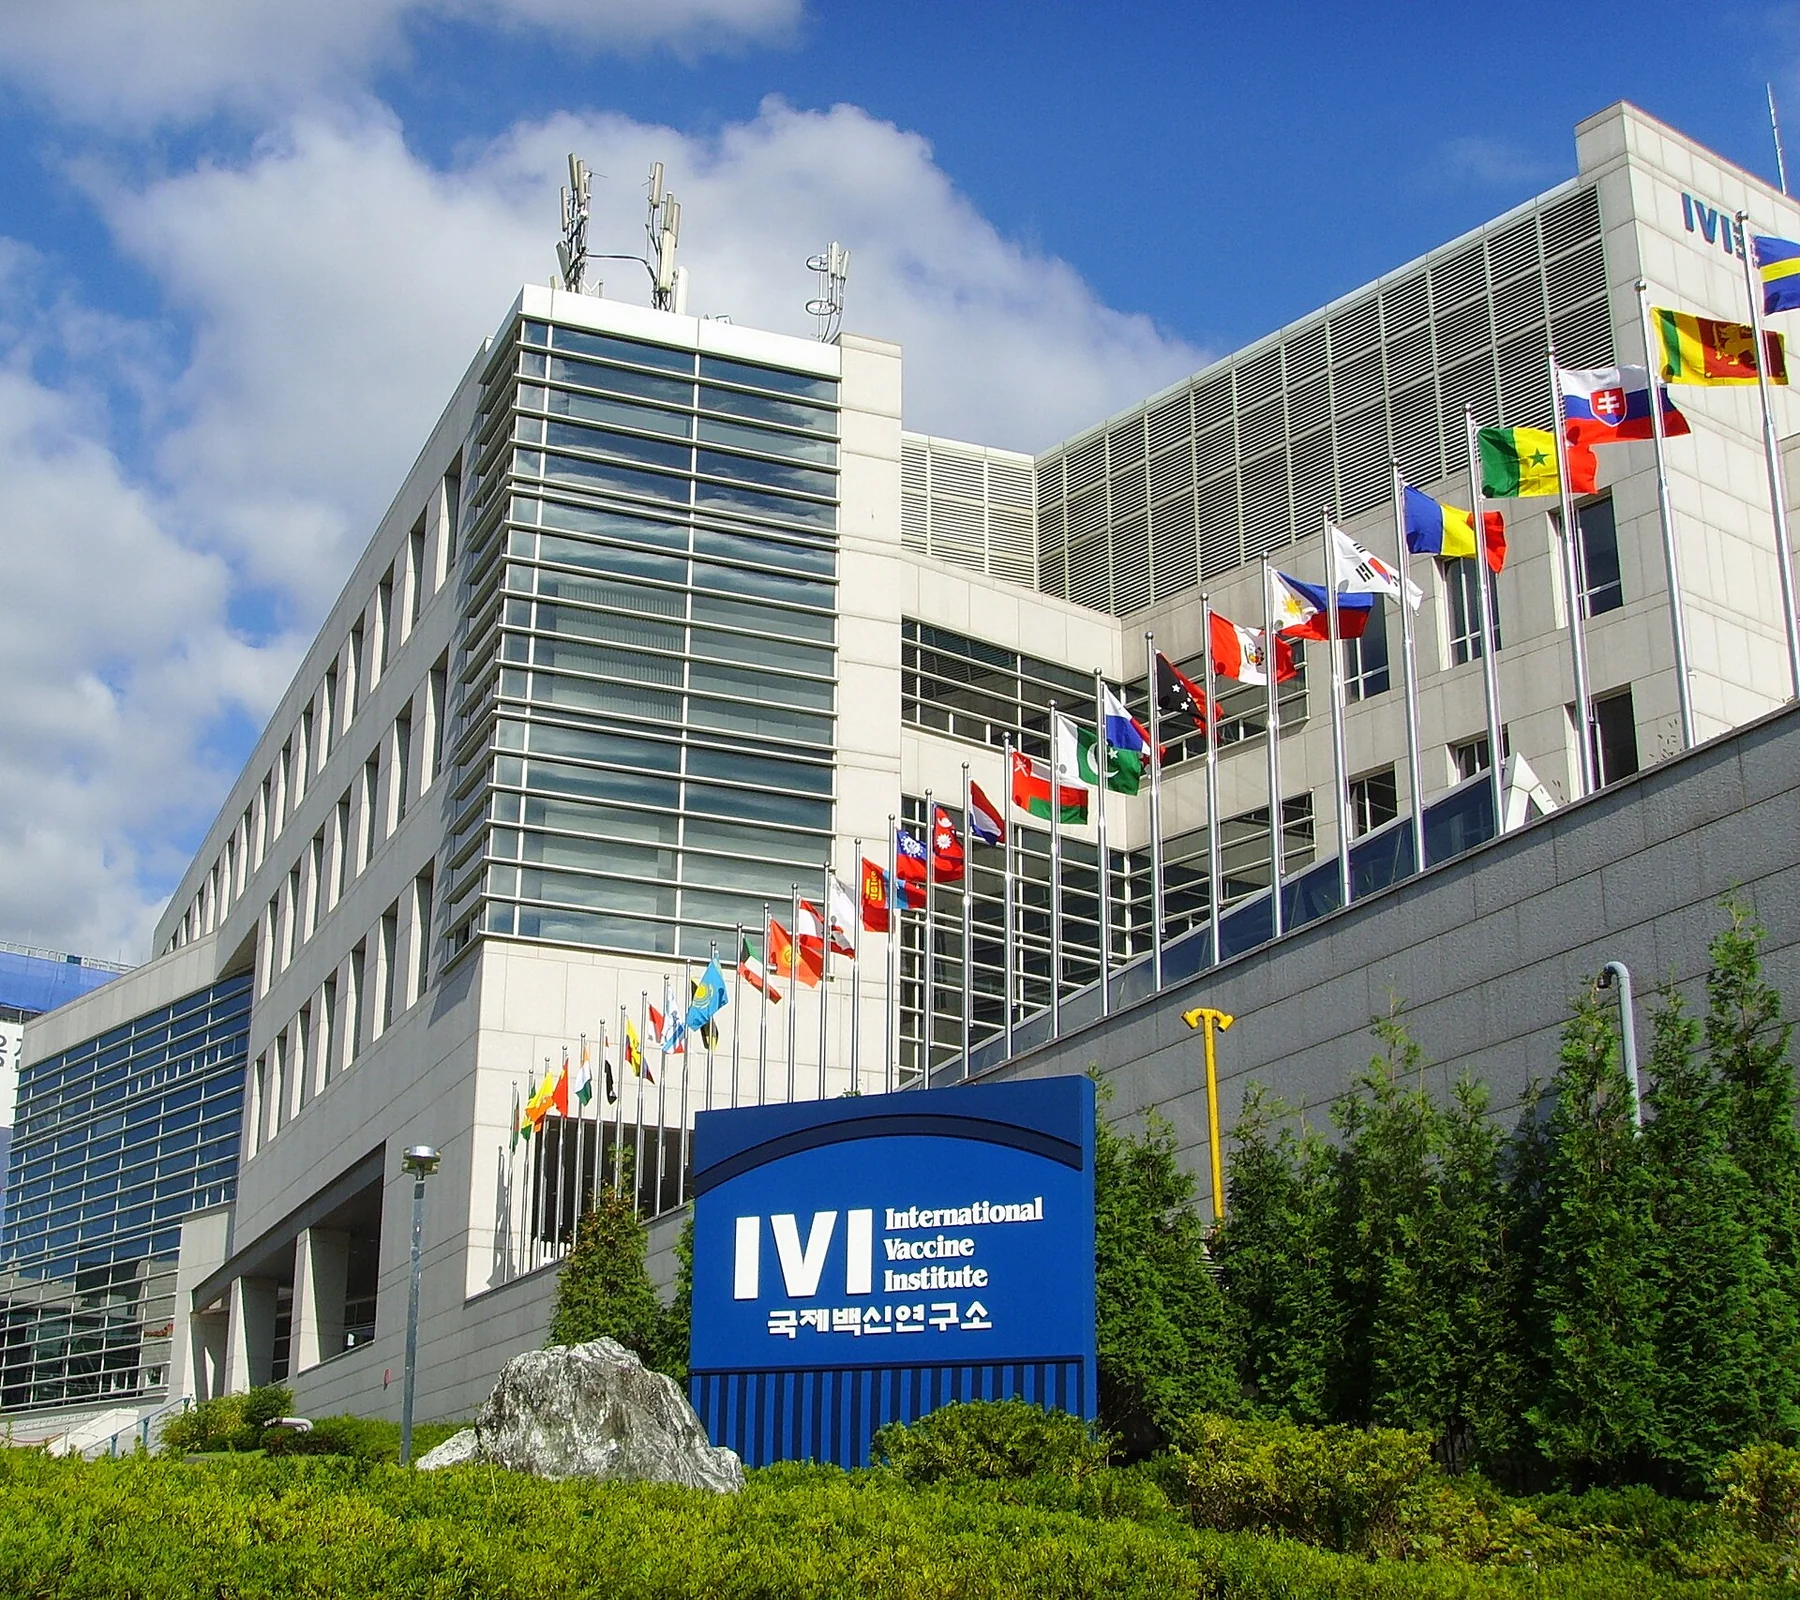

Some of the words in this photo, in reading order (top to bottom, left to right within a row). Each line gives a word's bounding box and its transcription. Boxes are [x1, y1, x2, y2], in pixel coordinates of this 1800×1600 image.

[1681, 192, 1732, 254] IVI
[885, 1197, 1044, 1230] International
[733, 1208, 874, 1300] IVI
[884, 1235, 975, 1261] Vaccine
[884, 1265, 988, 1293] Institute
[767, 1301, 992, 1338] 국제백신연구소
